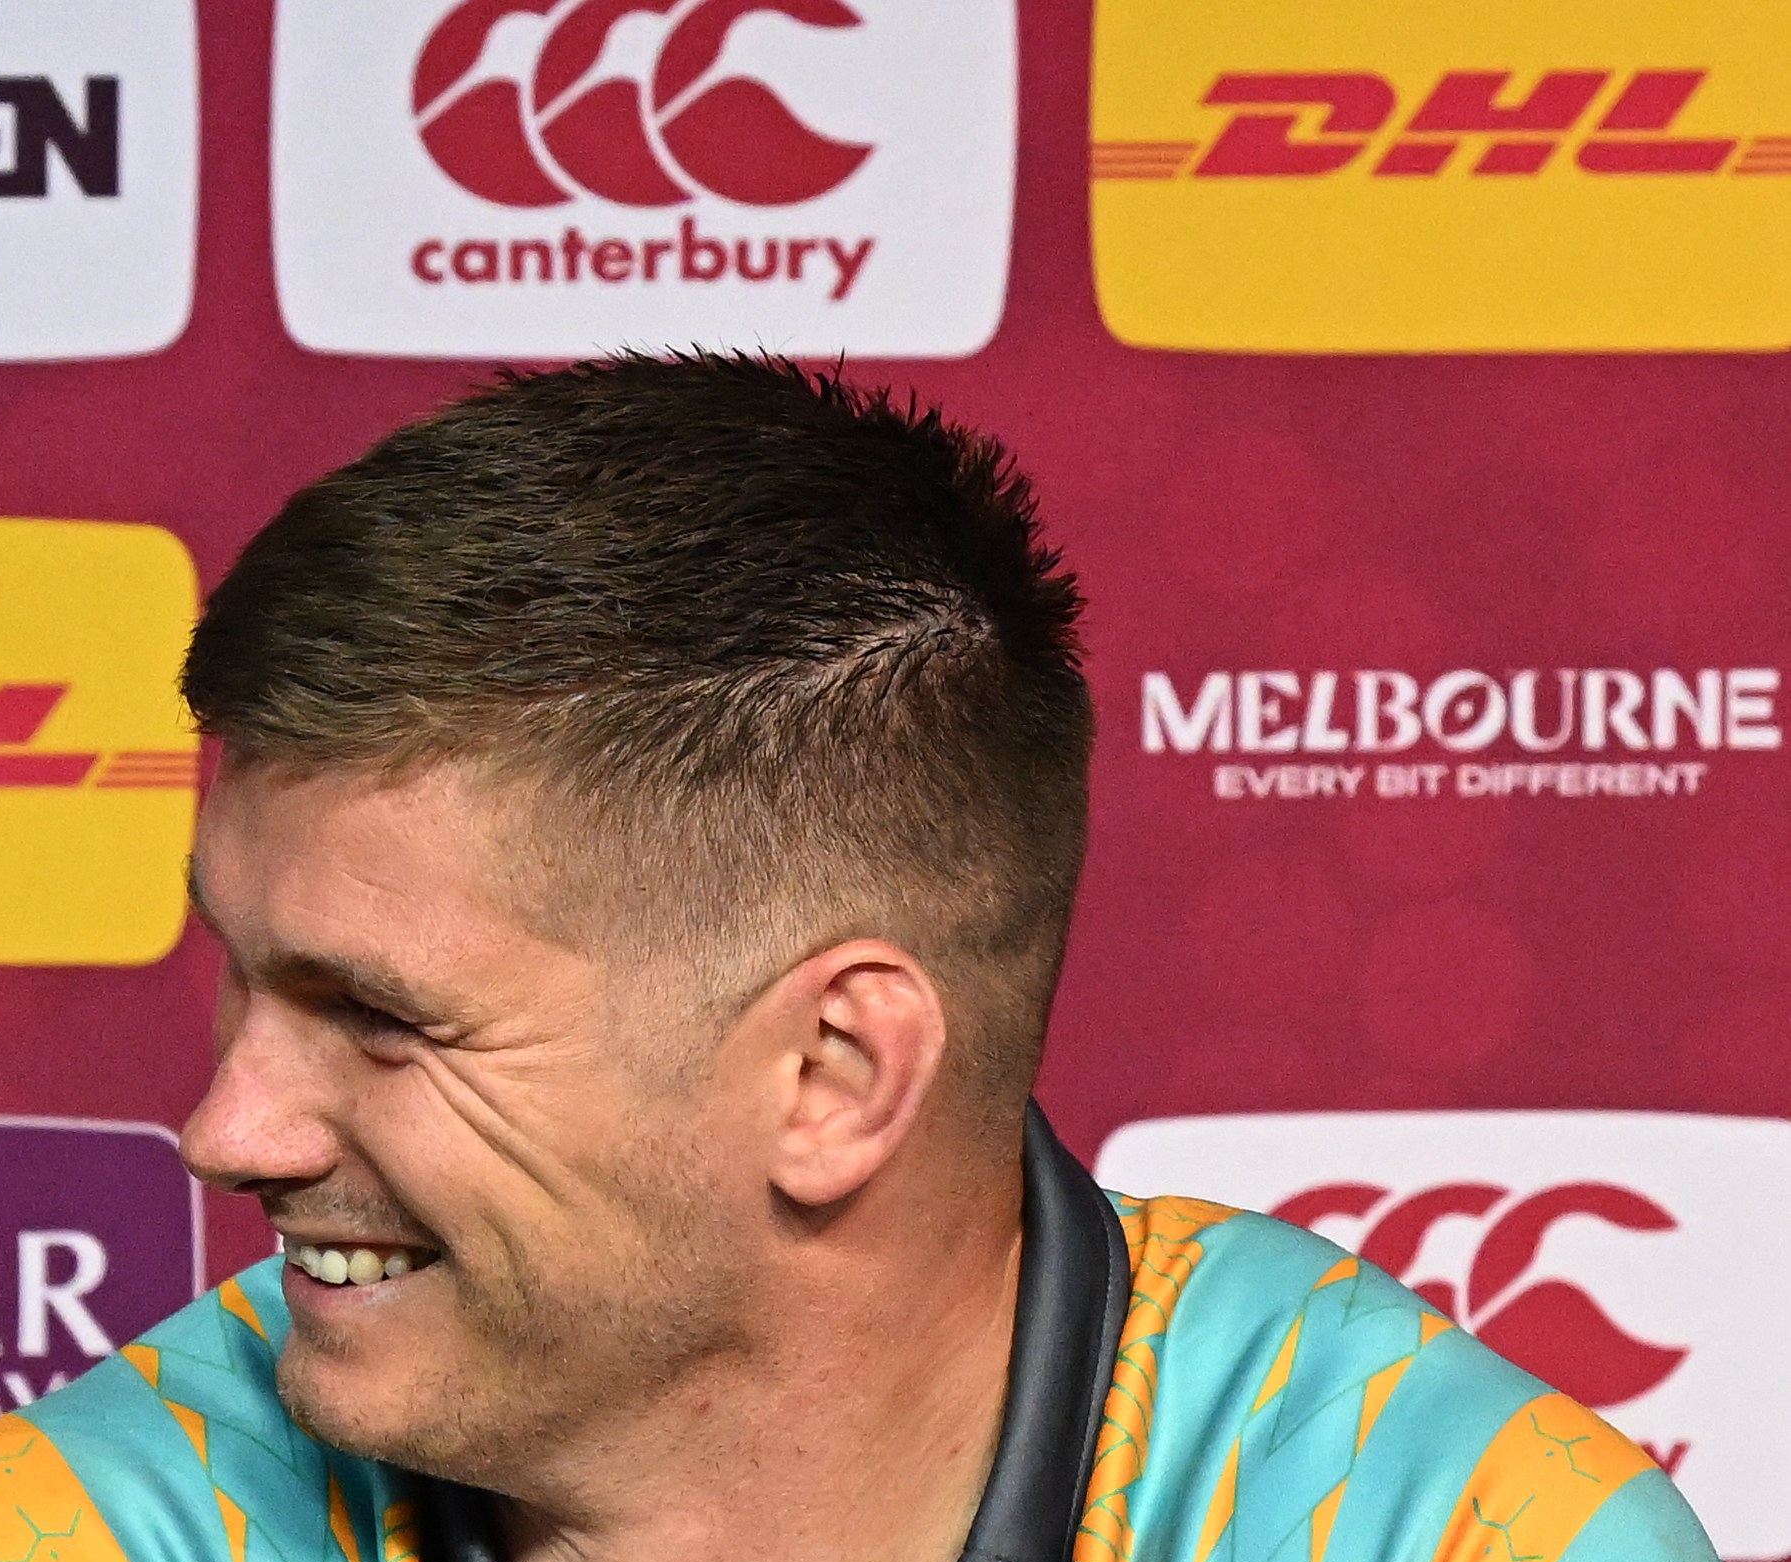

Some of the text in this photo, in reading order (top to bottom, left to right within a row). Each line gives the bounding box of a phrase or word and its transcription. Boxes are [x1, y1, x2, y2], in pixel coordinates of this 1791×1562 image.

[1191, 70, 1740, 178] DHL
[411, 216, 877, 300] canterbury
[1140, 668, 1782, 753] MELBOURNE
[1215, 762, 1707, 799] EVERY BIT DIFFERENT
